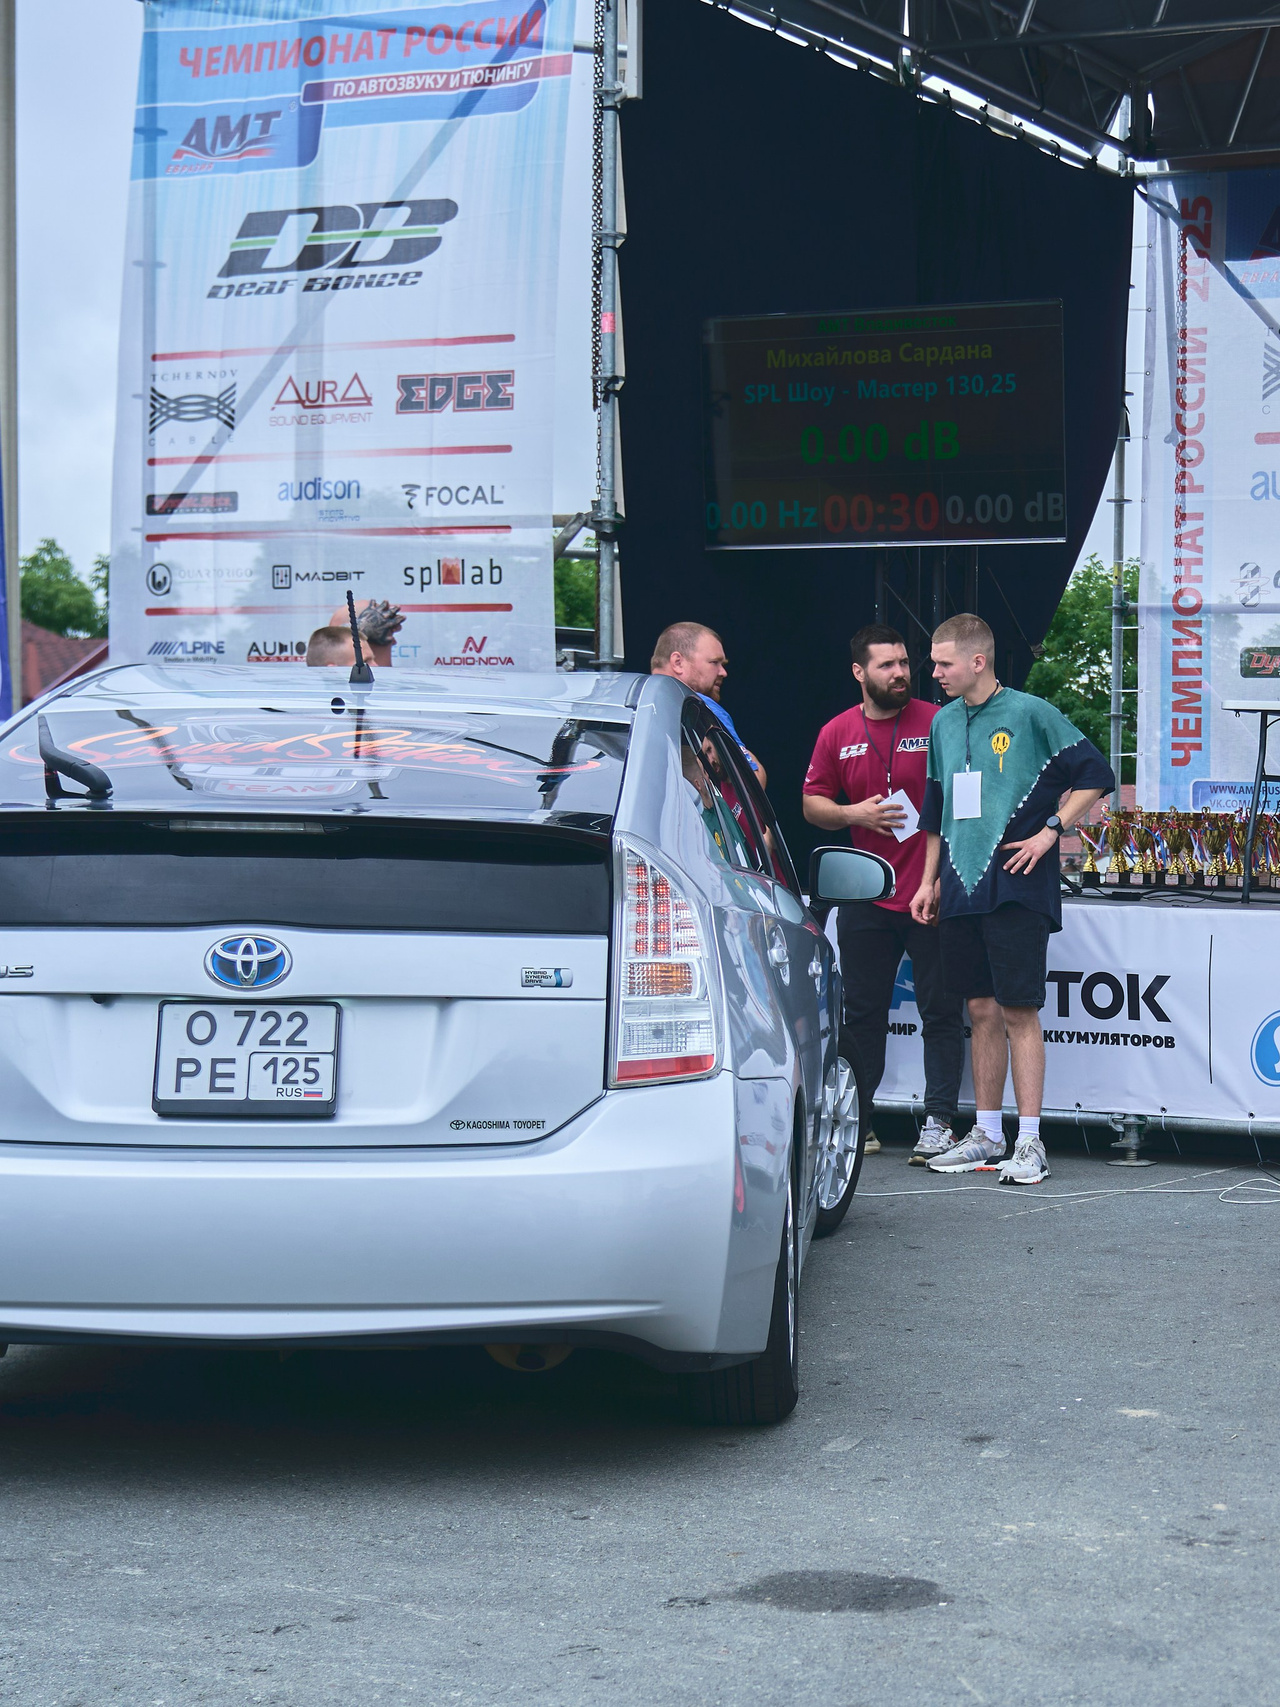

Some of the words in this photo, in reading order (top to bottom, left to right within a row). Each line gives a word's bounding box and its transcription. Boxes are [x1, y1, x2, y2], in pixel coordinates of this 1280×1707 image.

[179, 29, 397, 79] ЧЕМПИОНАТ
[404, 9, 544, 59] РОССИИ
[333, 80, 357, 97] ПО
[357, 72, 445, 95] АВТОЗВУКУ
[449, 71, 461, 88] И
[461, 62, 533, 87] ТЮНИНГУ
[1177, 194, 1214, 302] 2025
[854, 314, 958, 333] Владивосток
[766, 345, 892, 369] Михайлова
[899, 342, 993, 367] Сардана
[151, 369, 239, 383] TCHERNOV
[744, 384, 781, 404] SPL
[788, 383, 836, 406] Шоу
[857, 378, 938, 401] Мастер
[945, 373, 1017, 397] 130,25
[269, 415, 309, 427] SOUND
[310, 412, 374, 425] EQUIPMENT
[1175, 327, 1209, 494] РОССИИ
[148, 434, 235, 448] CABLE
[801, 423, 890, 465] 0.00
[904, 419, 960, 462] dB
[278, 477, 361, 502] audison
[425, 485, 501, 506] FOCAL
[706, 500, 768, 531] 0.00
[779, 499, 819, 528] Hz
[824, 490, 940, 533] 00:30
[945, 494, 1014, 524] 0.00
[1024, 491, 1065, 522] dB
[295, 571, 365, 582] MADBIT
[1171, 507, 1205, 767] ЧЕМПИОНАТ
[221, 783, 334, 794] TEAM
[1046, 970, 1172, 1023] ТОК
[233, 1010, 309, 1047] 722
[887, 1022, 917, 1036] МИР
[1043, 1030, 1176, 1049] ККУМУЛЯТОРОВ
[262, 1056, 320, 1085] 125
[276, 1086, 302, 1098] RUS
[466, 1120, 510, 1129] KAGOSHIMA
[513, 1120, 546, 1129] TOYOPET
